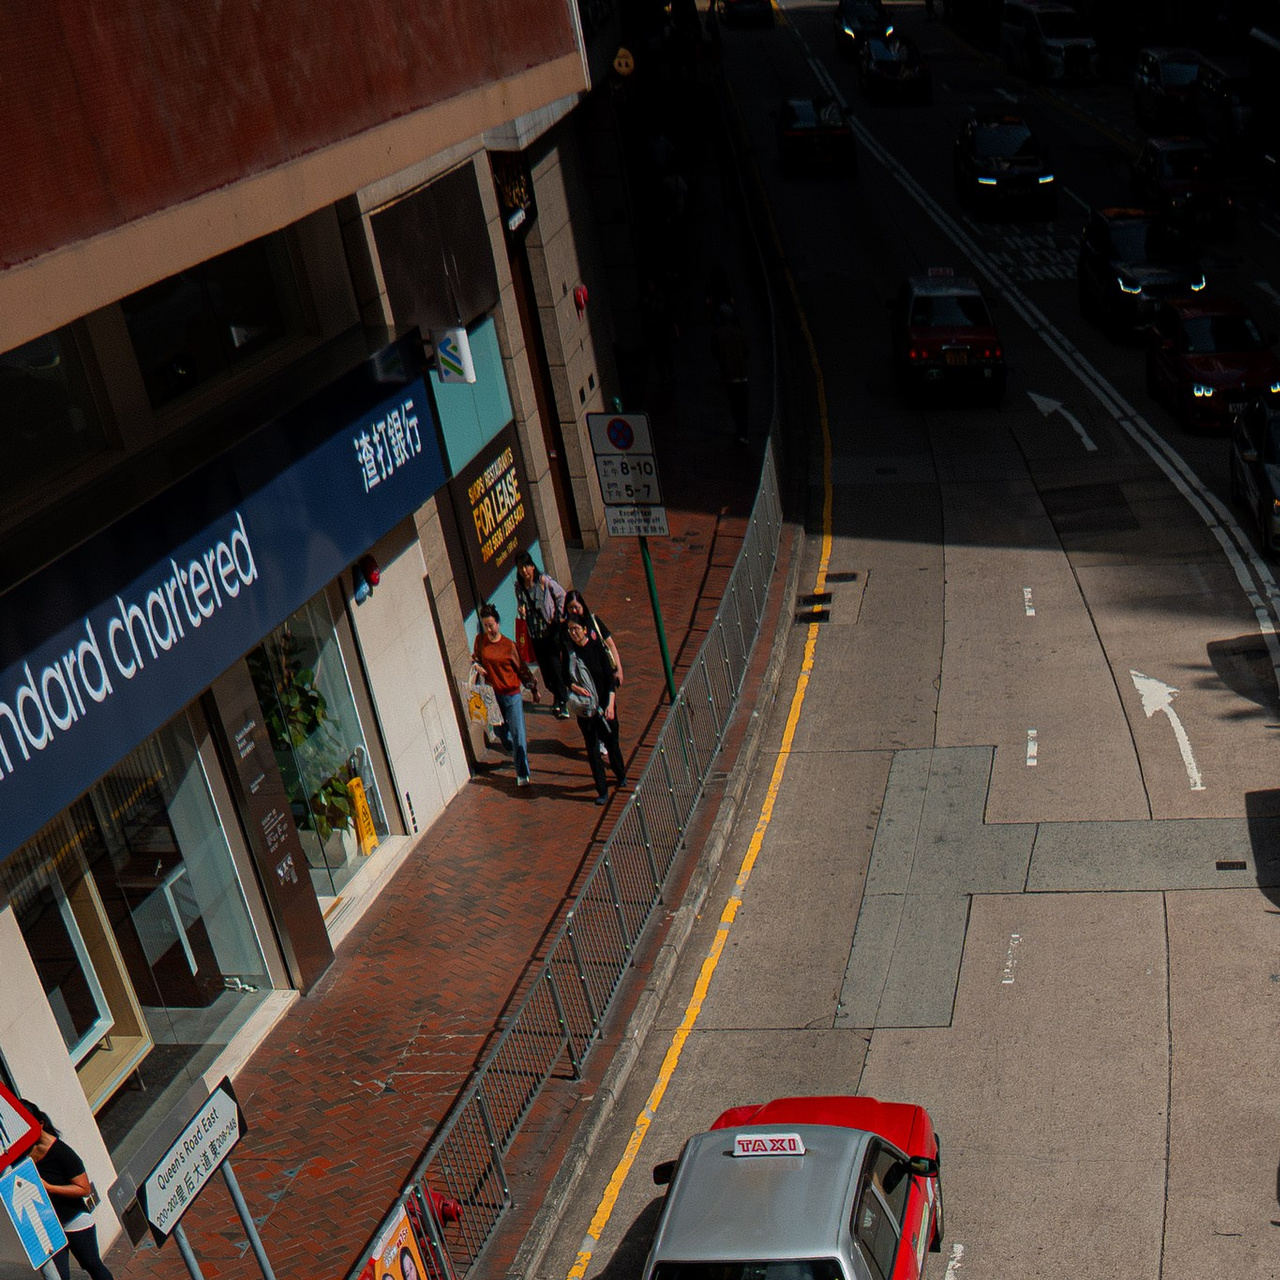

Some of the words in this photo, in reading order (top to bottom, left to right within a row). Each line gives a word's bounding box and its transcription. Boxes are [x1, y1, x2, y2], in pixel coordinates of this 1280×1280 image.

[353, 399, 423, 493] 渣打銀行
[620, 462, 653, 475] 8-10
[472, 496, 496, 545] FOR
[491, 467, 522, 524] LEASE
[625, 484, 651, 497] 5-7
[0, 617, 114, 781] ndard
[107, 512, 259, 680] chartered
[157, 1150, 185, 1191] Queen's
[182, 1125, 203, 1157] Road
[201, 1106, 219, 1134] East
[175, 1140, 221, 1207] 皇后大道東
[738, 1138, 796, 1152] TAXI
